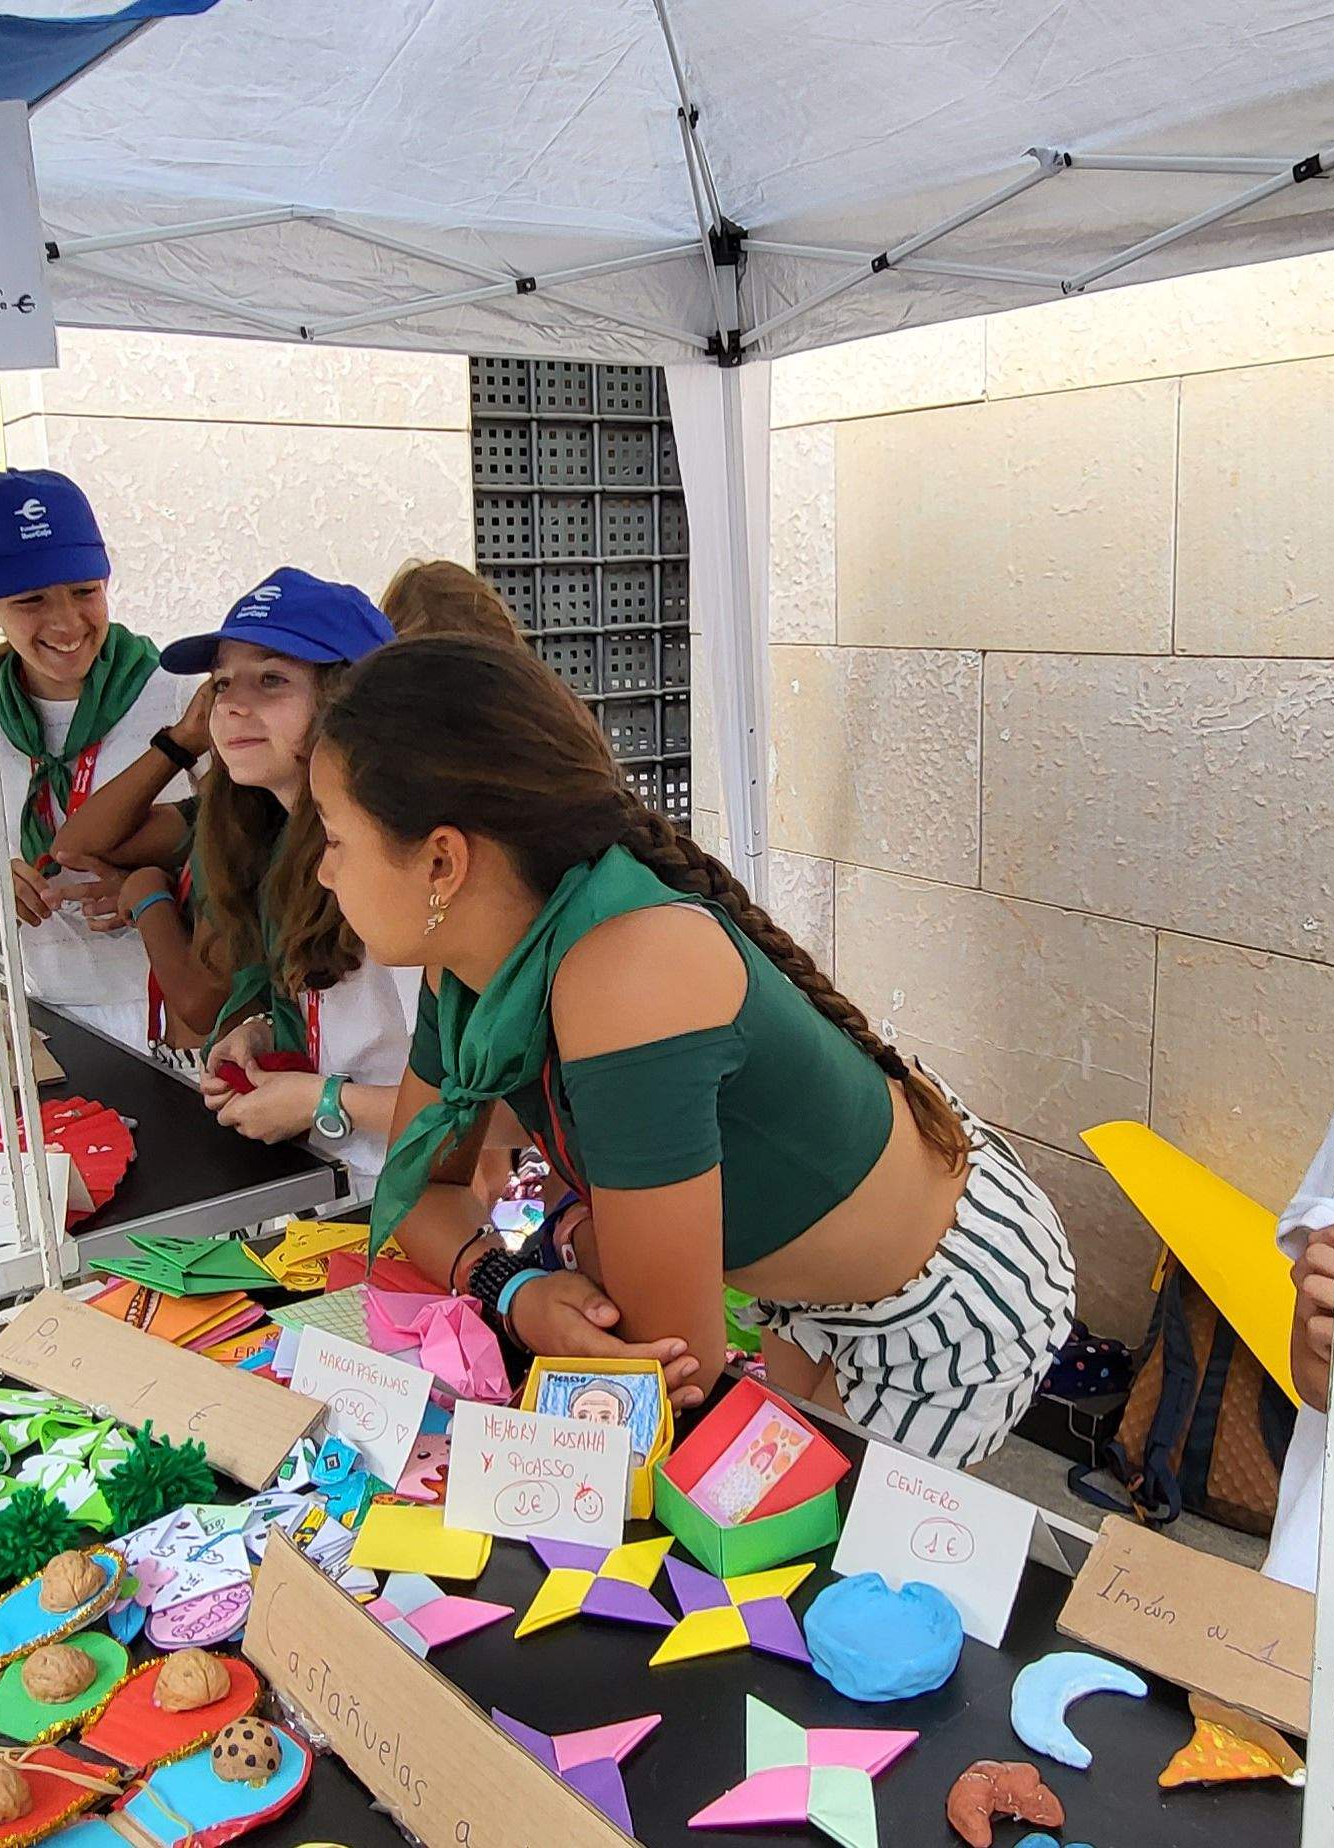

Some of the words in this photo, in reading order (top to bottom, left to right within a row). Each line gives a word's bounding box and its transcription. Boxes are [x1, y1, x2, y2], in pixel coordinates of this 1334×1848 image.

[546, 1373, 587, 1383] Picasso
[1096, 1564, 1176, 1625] Imán
[1207, 1624, 1229, 1641] a
[266, 1582, 428, 1807] Castañuelas
[454, 1819, 471, 1848] a
